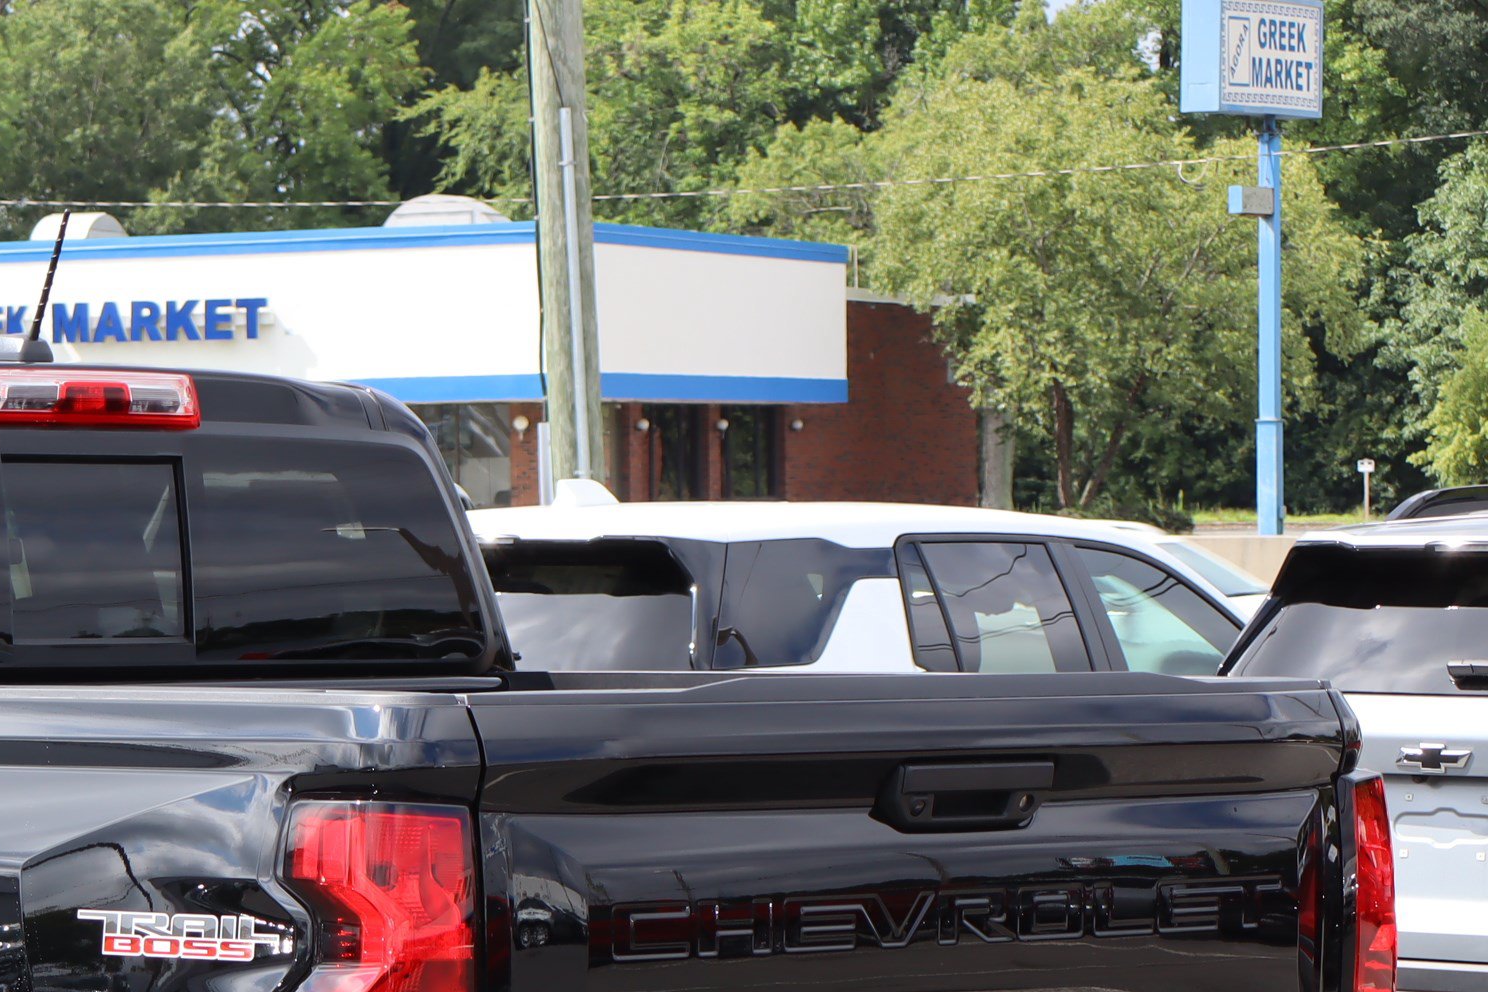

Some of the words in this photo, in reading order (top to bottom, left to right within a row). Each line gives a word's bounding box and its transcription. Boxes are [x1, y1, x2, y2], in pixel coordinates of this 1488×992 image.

[1229, 23, 1250, 80] AGORA
[1257, 17, 1307, 53] GREEK
[1251, 56, 1313, 92] MARKET
[52, 298, 268, 344] MARKET
[77, 909, 280, 944] TRAIL
[612, 879, 1283, 962] CHEVROLET
[102, 935, 255, 962] BOSS
